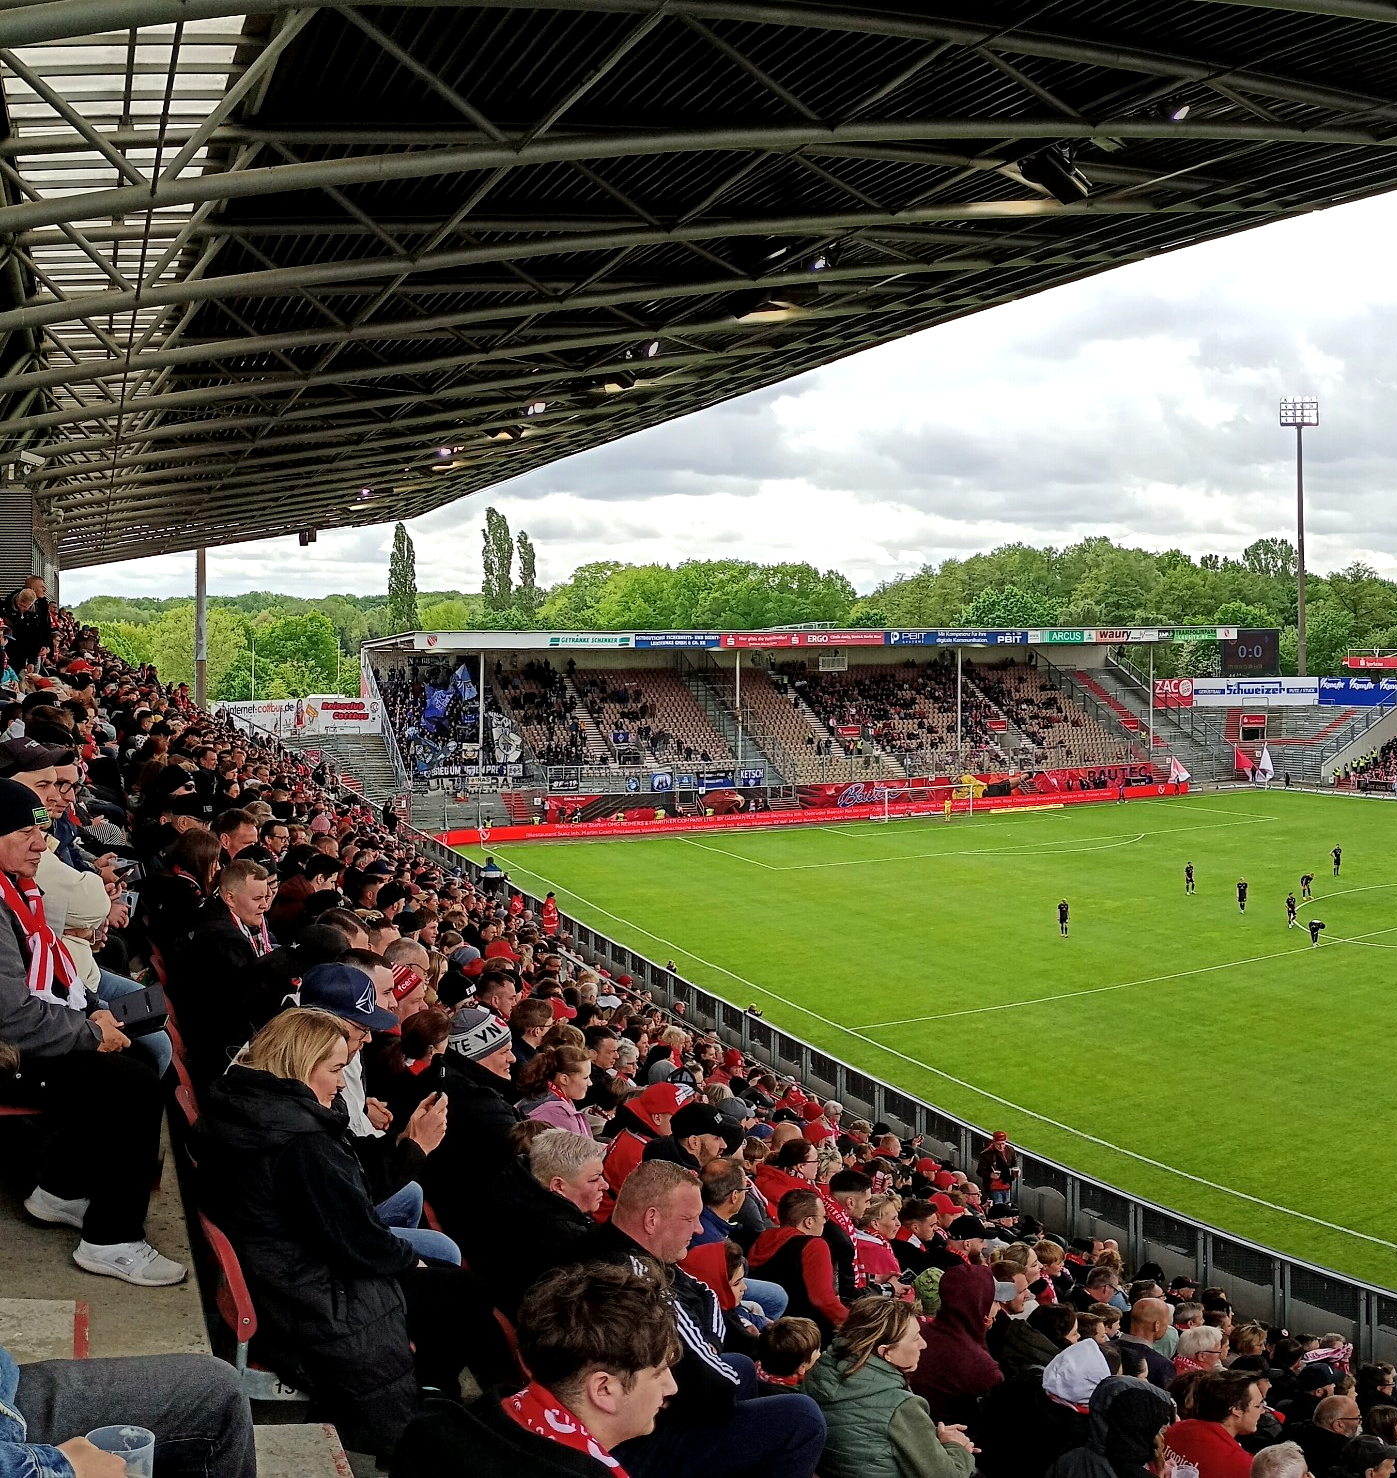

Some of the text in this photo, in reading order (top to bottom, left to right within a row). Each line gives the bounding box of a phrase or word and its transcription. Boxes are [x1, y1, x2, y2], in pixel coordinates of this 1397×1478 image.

[808, 634, 828, 643] ERGO
[1052, 632, 1080, 640] ARCUS
[1100, 630, 1132, 640] waury
[1238, 646, 1262, 658] 0:0
[1154, 680, 1178, 694] ZAC
[1226, 686, 1285, 695] Schweizer
[321, 702, 365, 710] Reiseclub
[332, 712, 369, 720] Cottbus
[450, 766, 460, 775] UM
[486, 766, 506, 775] PRES
[741, 768, 764, 778] KETSCH
[474, 1022, 503, 1044] YN
